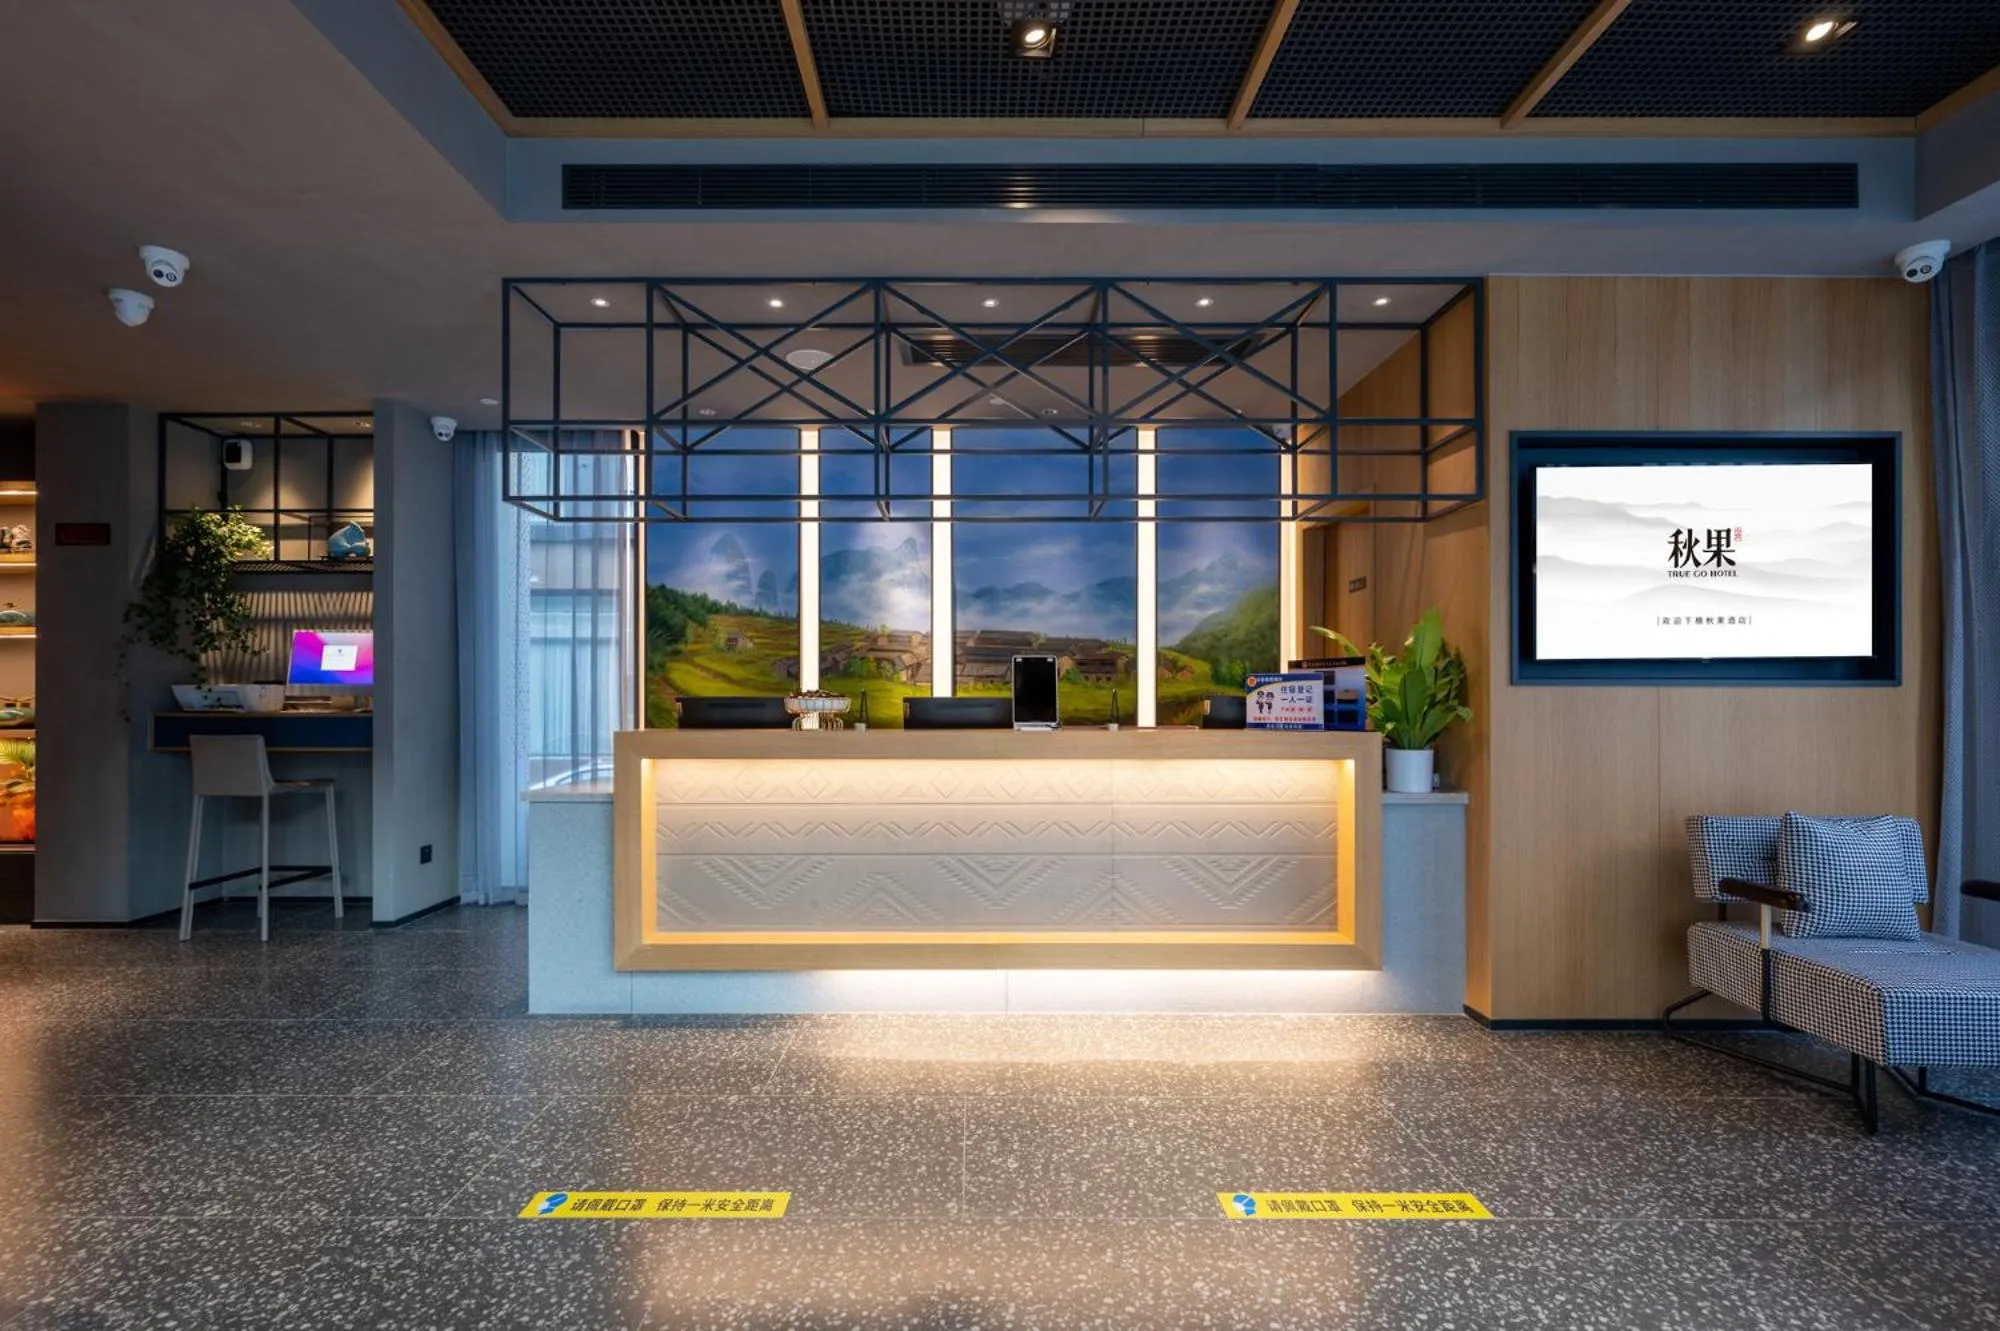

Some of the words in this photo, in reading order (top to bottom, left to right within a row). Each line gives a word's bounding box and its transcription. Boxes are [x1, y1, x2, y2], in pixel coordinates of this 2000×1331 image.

[1667, 528, 1736, 568] 秋果
[1667, 570, 1691, 578] TRUE
[1693, 570, 1708, 578] GO
[1710, 570, 1737, 578] HOTEL
[570, 1198, 647, 1213] 请佩戴口罩
[655, 1198, 774, 1213] 保持一米安全距离
[1265, 1199, 1343, 1213] 请佩戴口罩
[1352, 1199, 1475, 1214] 保持一米安全距离
